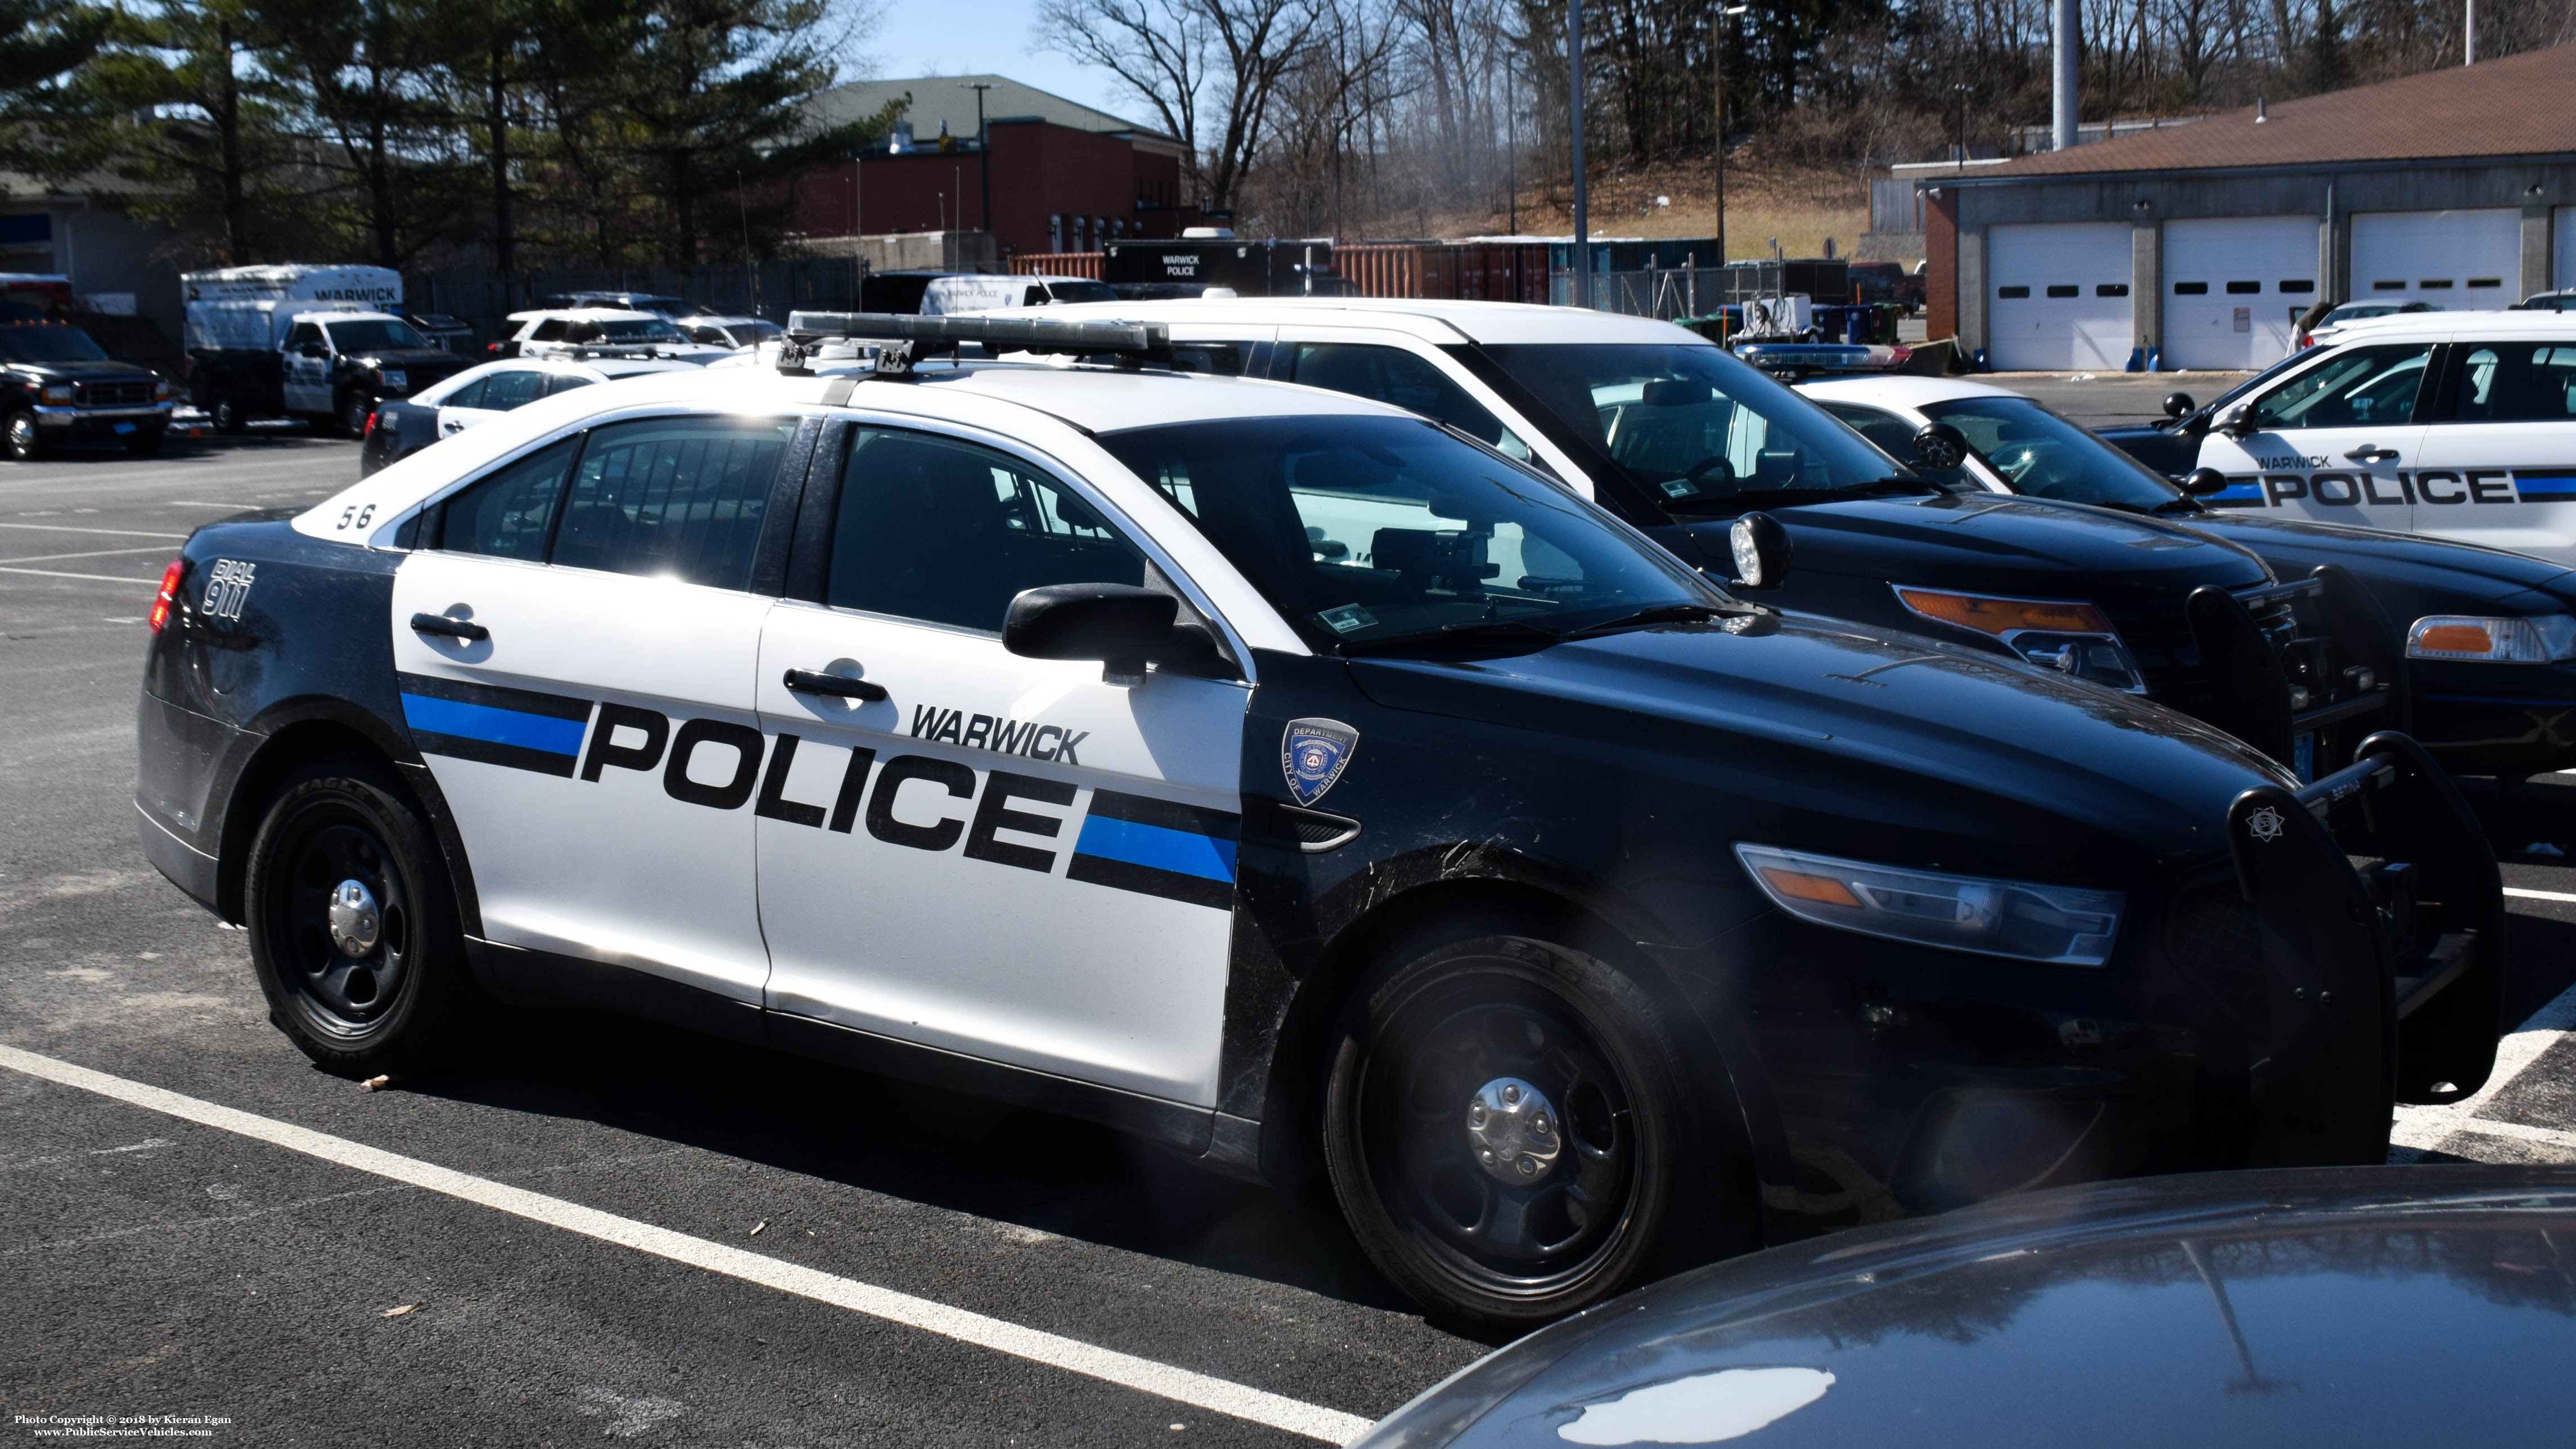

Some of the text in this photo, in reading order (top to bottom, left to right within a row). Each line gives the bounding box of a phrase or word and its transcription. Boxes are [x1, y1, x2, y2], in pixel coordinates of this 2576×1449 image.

[1163, 255, 1200, 264] WARWICK
[1167, 266, 1195, 276] POLICE
[315, 288, 396, 300] WARWICK
[2255, 455, 2331, 469] WARWICK
[2263, 470, 2515, 507] POLICE
[336, 504, 376, 530] 56
[210, 559, 257, 584] DIAL
[201, 578, 250, 619] 911
[911, 704, 1090, 765] WARWICK
[1294, 728, 1348, 743] DEPARTMENT
[1283, 752, 1301, 791] CITY OF
[1313, 756, 1347, 796] WARWICK
[580, 702, 1079, 873] POLICE
